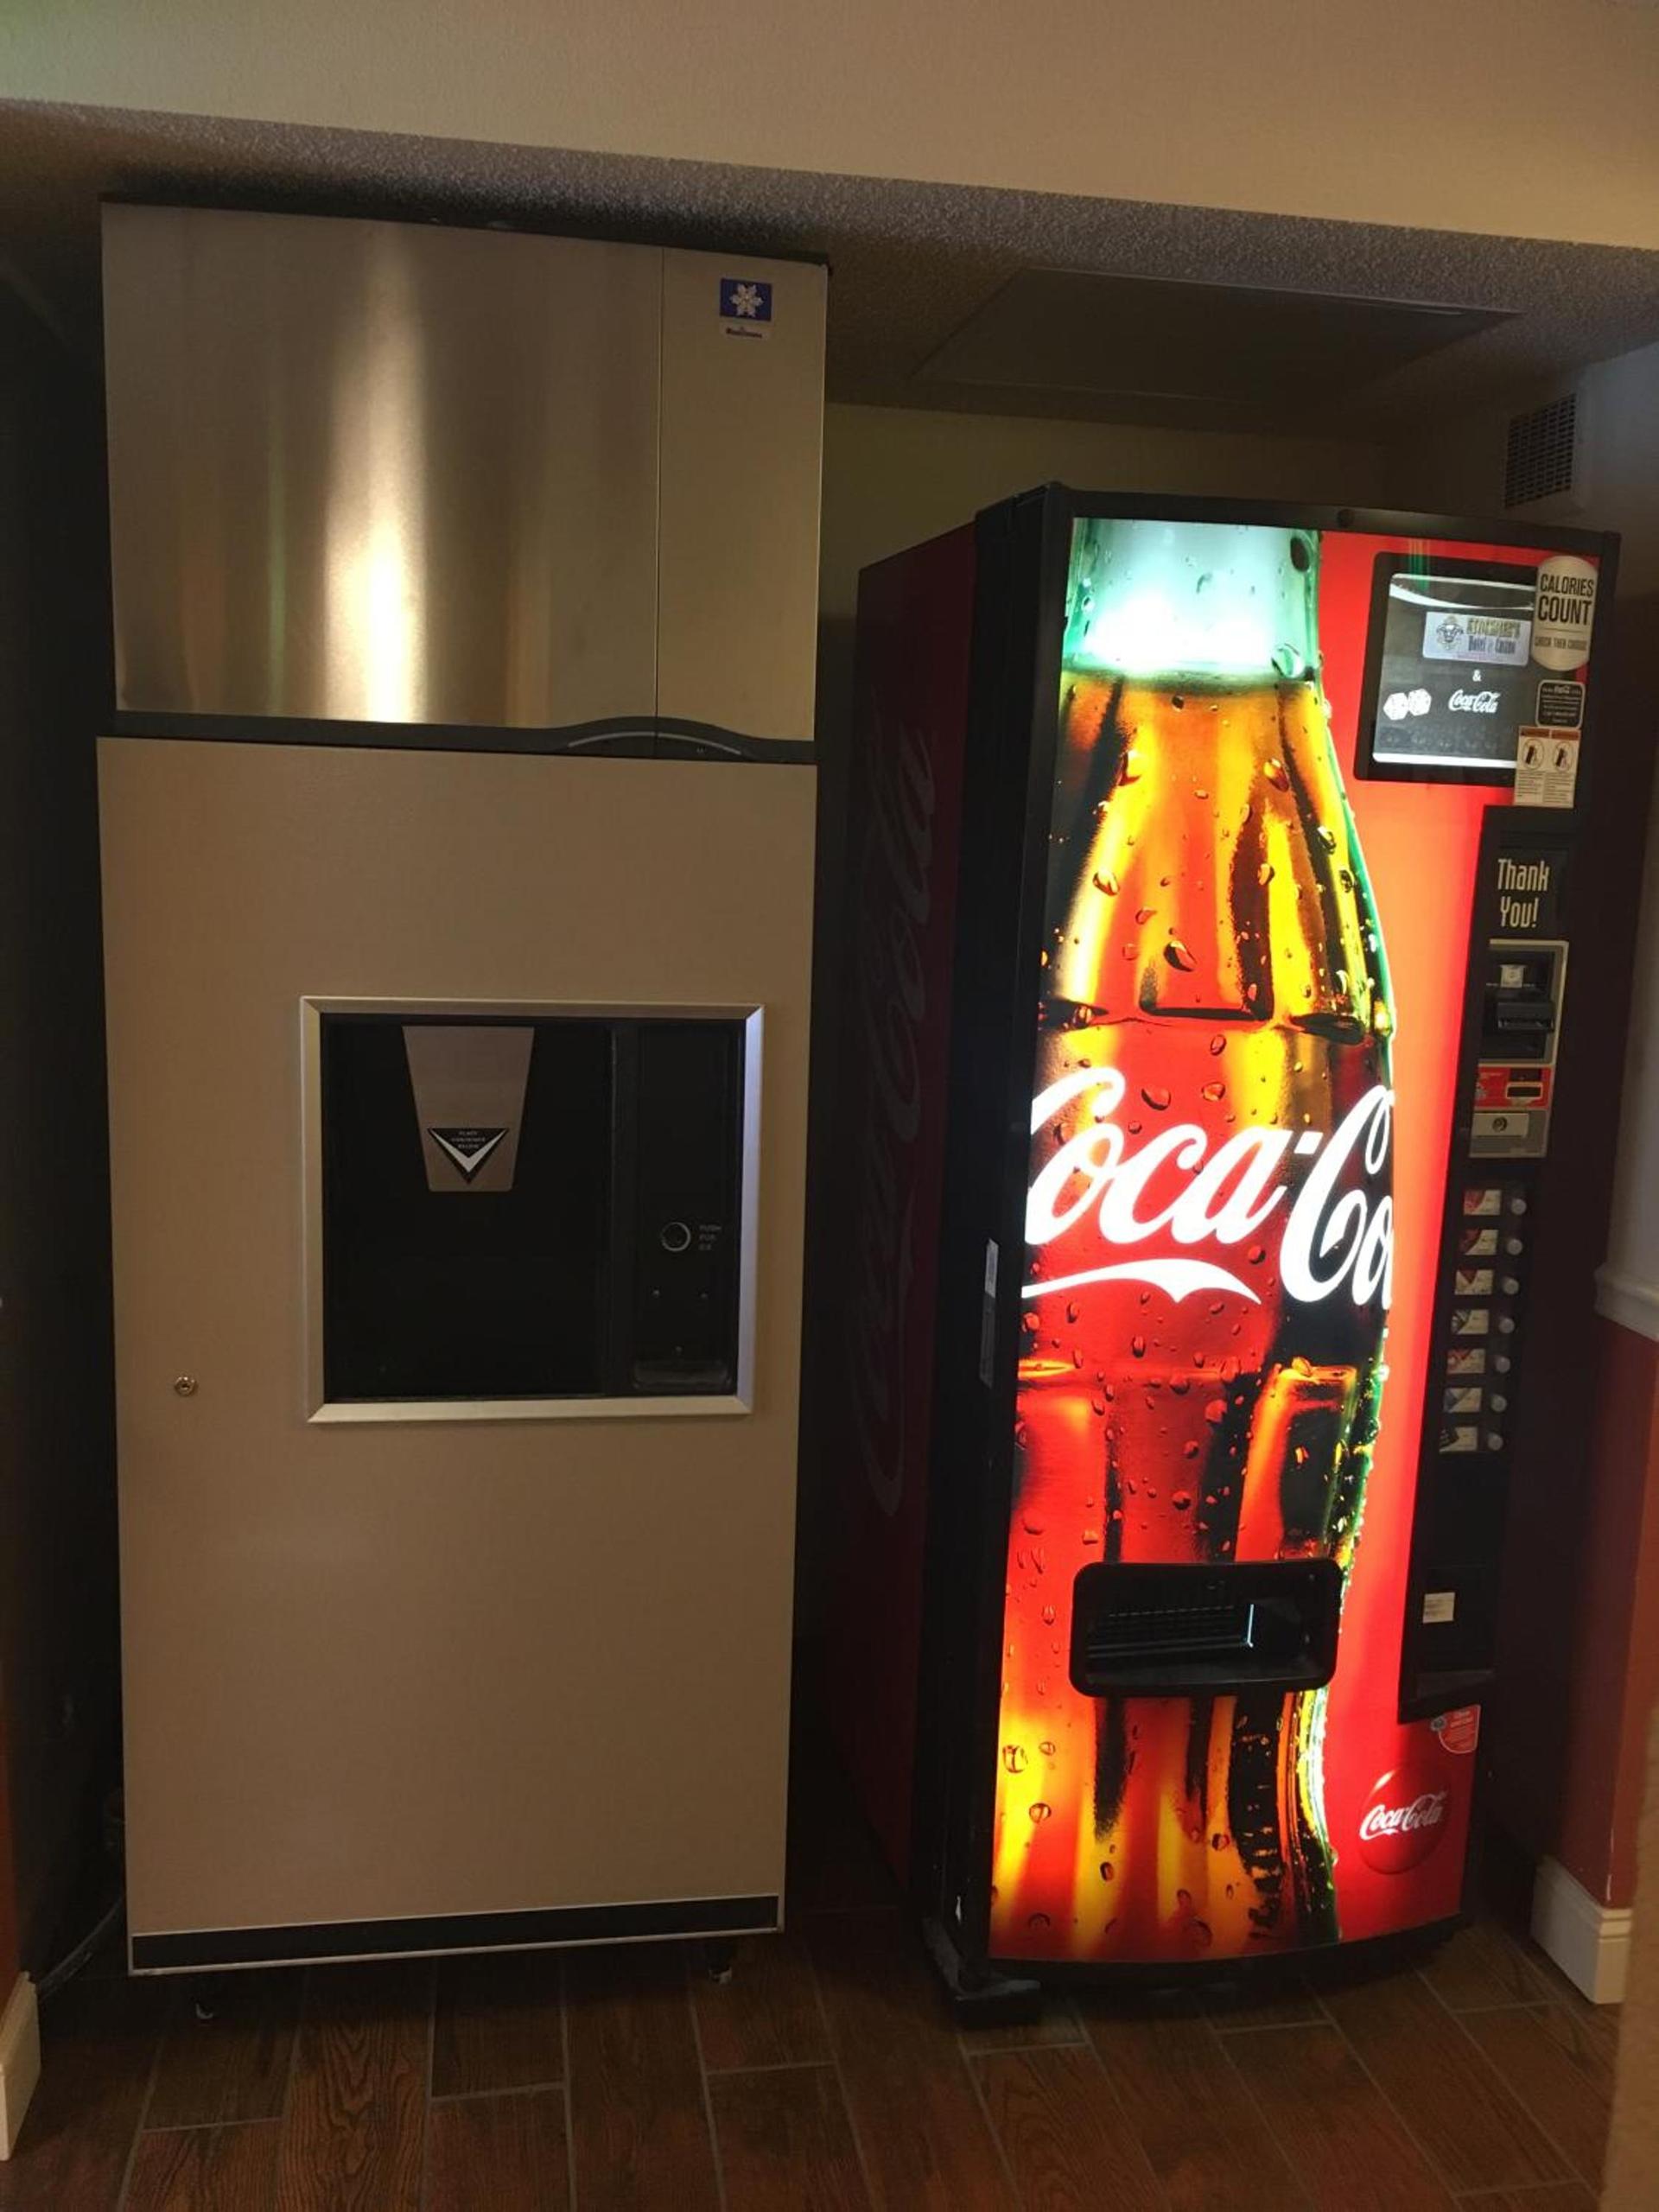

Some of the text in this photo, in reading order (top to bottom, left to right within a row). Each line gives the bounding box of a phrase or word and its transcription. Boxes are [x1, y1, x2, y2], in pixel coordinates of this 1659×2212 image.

[1541, 573, 1594, 597] CALORIES
[1538, 595, 1592, 626] COUNT
[1472, 670, 1482, 682] &
[1497, 858, 1550, 891] Thank
[1500, 896, 1539, 928] You!
[1022, 1066, 1395, 1310] Coca-Co
[1359, 1790, 1449, 1841] Coca-Cola
